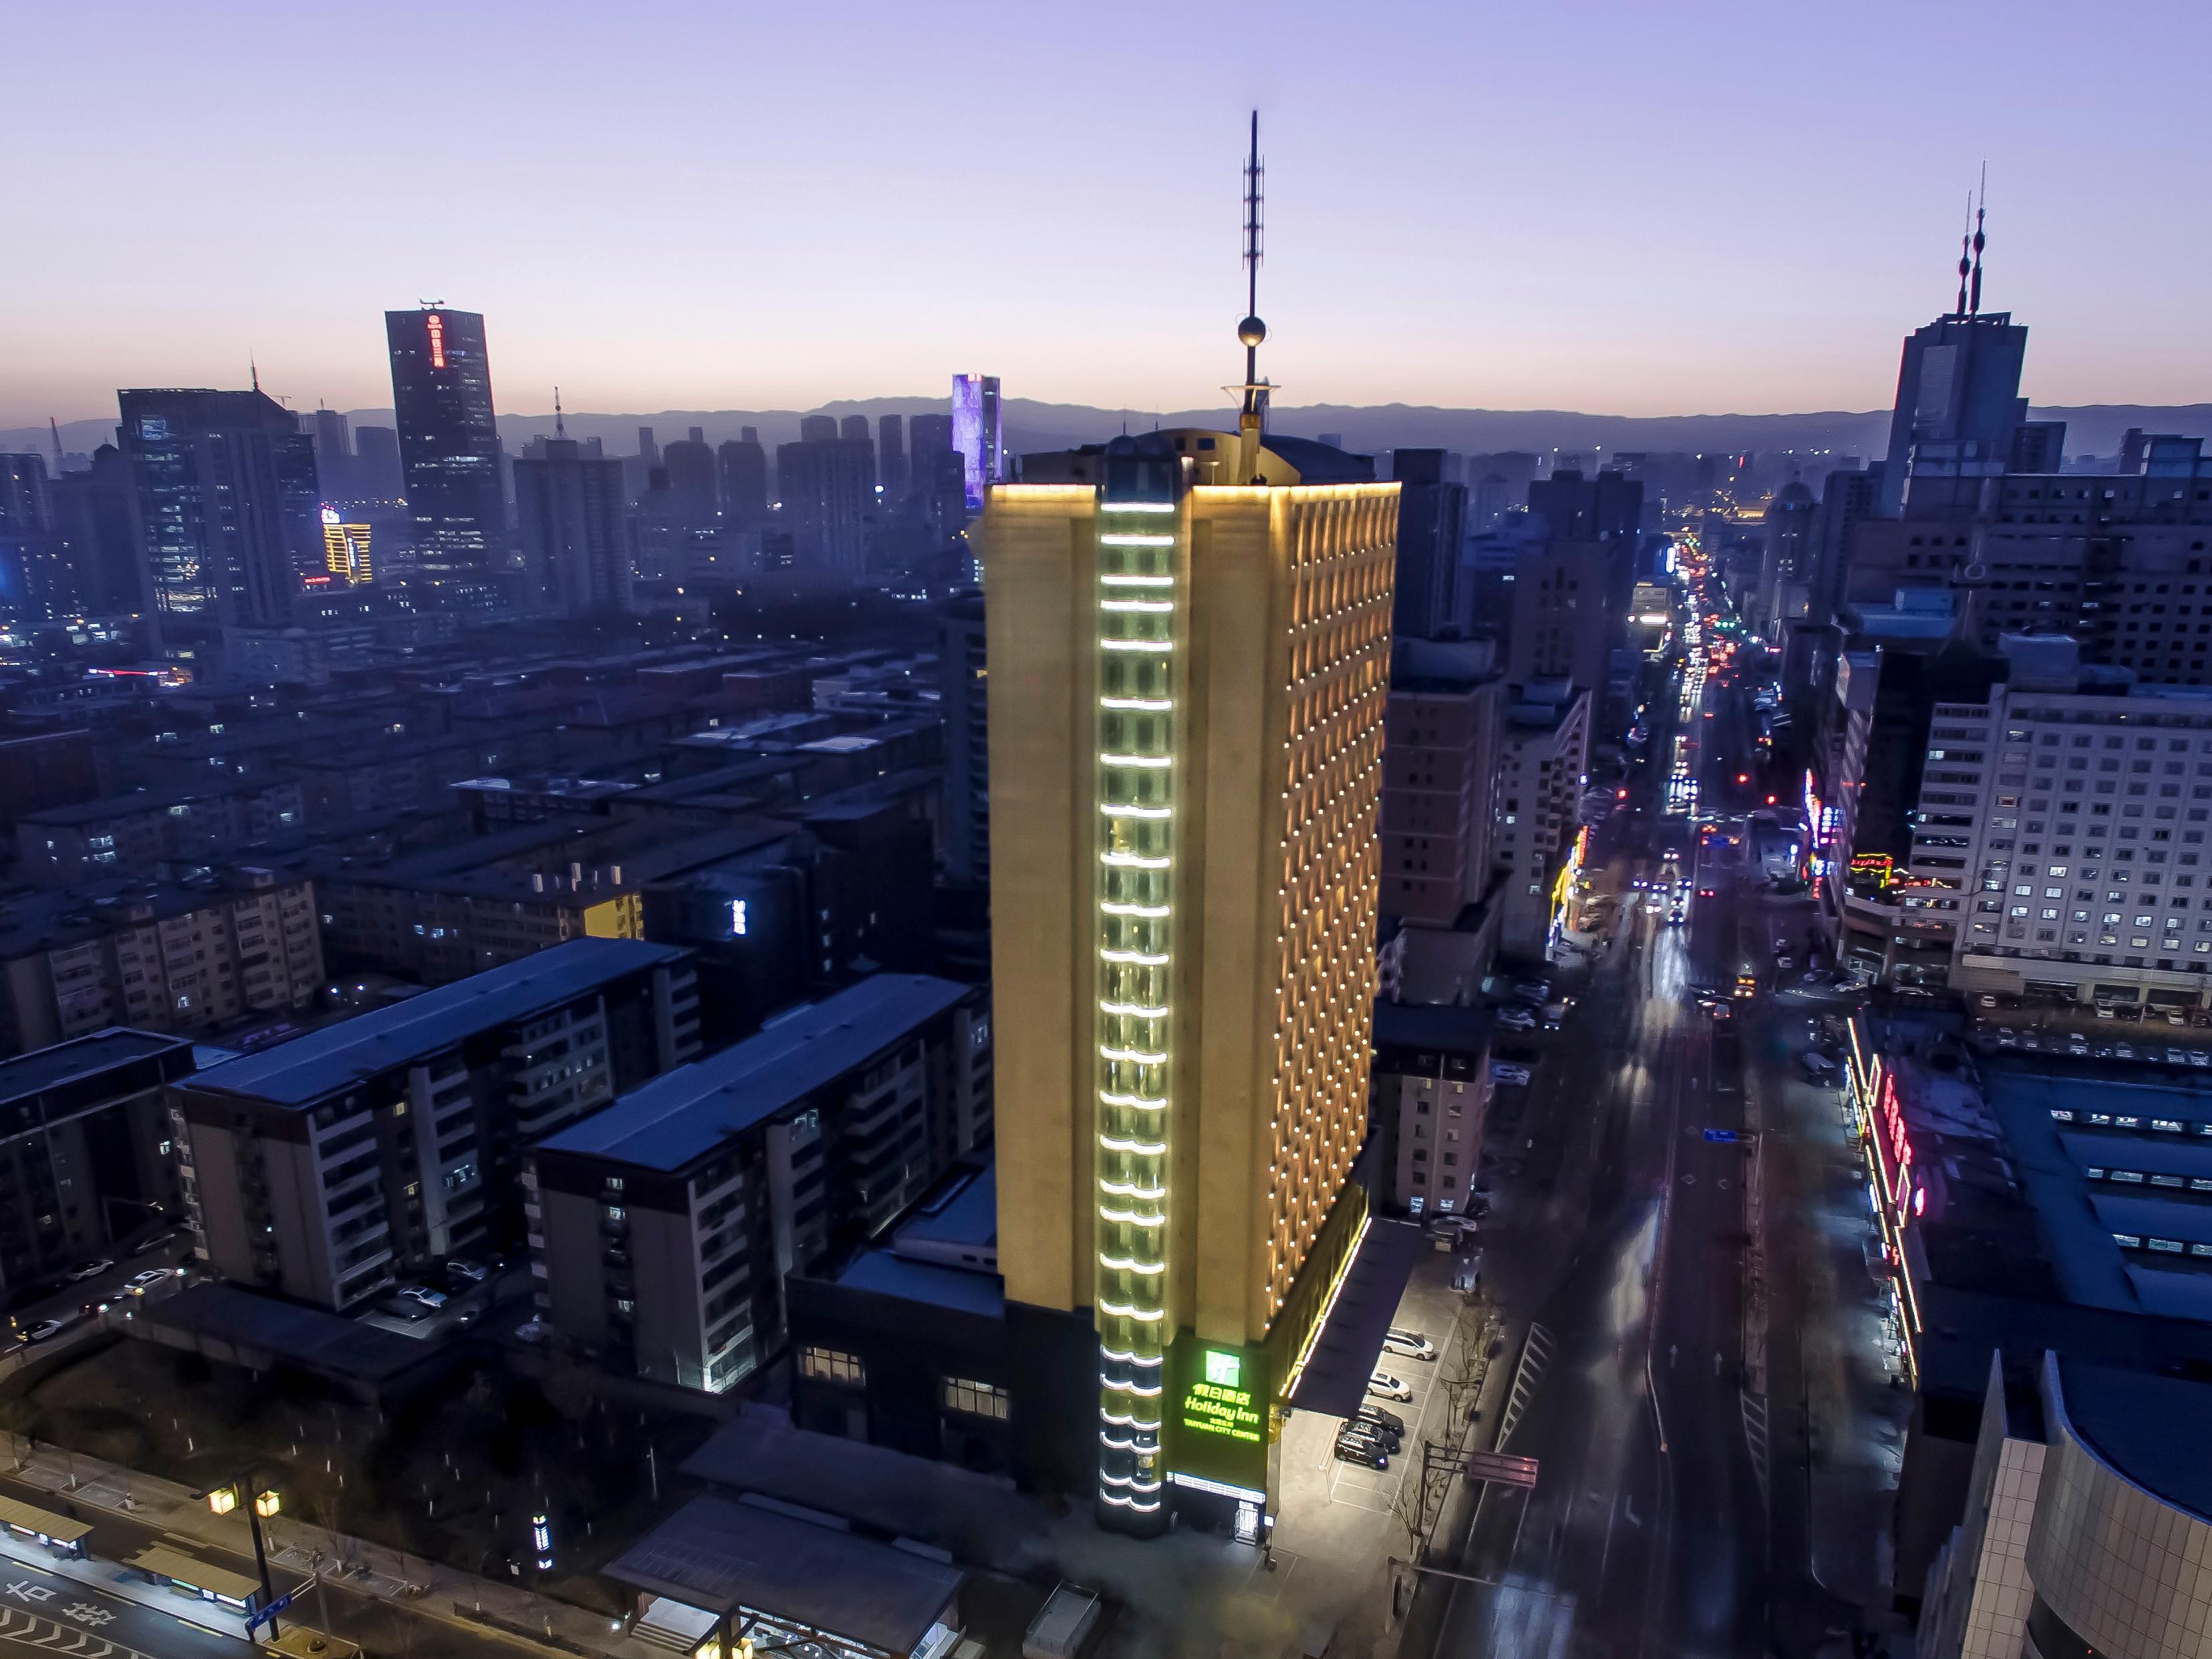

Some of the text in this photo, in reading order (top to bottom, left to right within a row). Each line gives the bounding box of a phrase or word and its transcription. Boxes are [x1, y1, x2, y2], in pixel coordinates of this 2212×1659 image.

[1193, 1383, 1251, 1406] 假日酒店
[1184, 1396, 1259, 1424] Holiday Inn
[1184, 1418, 1260, 1442] TAIYUAN CITY CENTER
